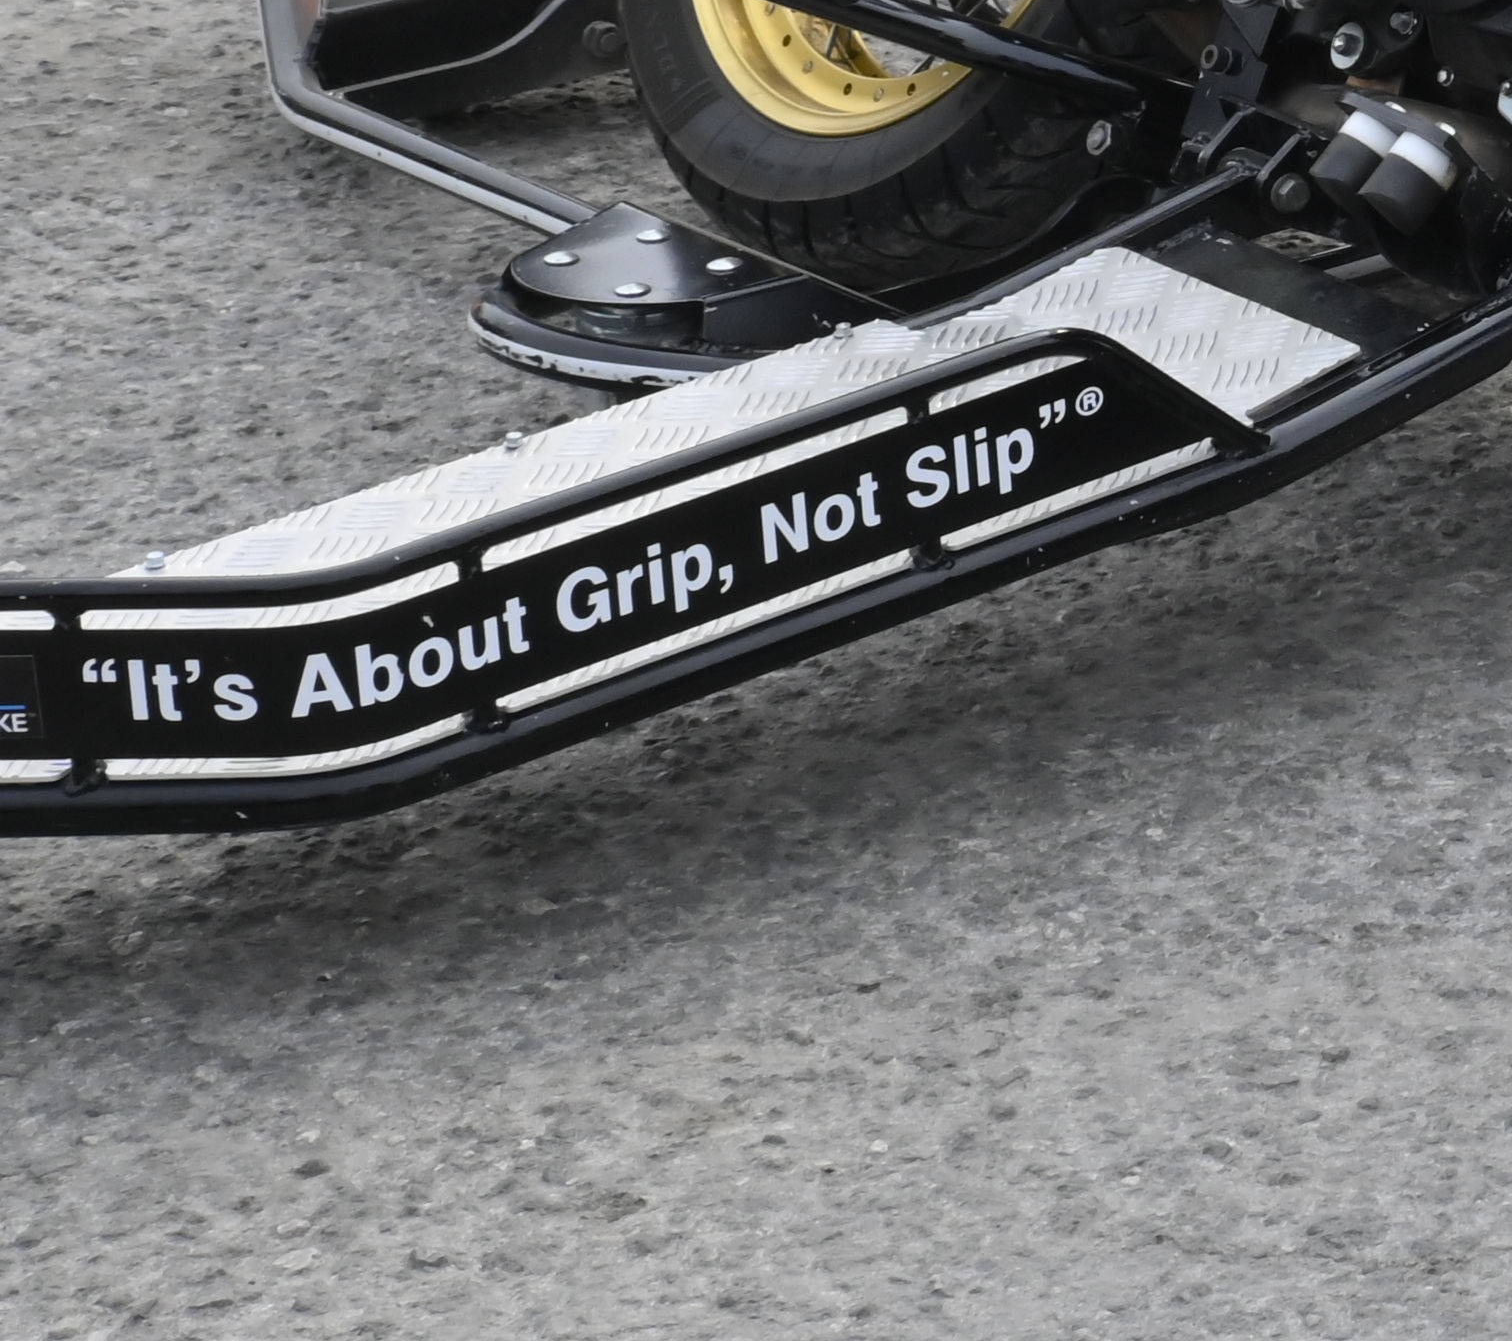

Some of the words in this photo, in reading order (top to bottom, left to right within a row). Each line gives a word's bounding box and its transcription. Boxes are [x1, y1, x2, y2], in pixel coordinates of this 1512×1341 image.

[81, 657, 259, 722] “It’s
[291, 596, 530, 719] About
[555, 542, 735, 633] Grip,
[761, 471, 882, 565] Not
